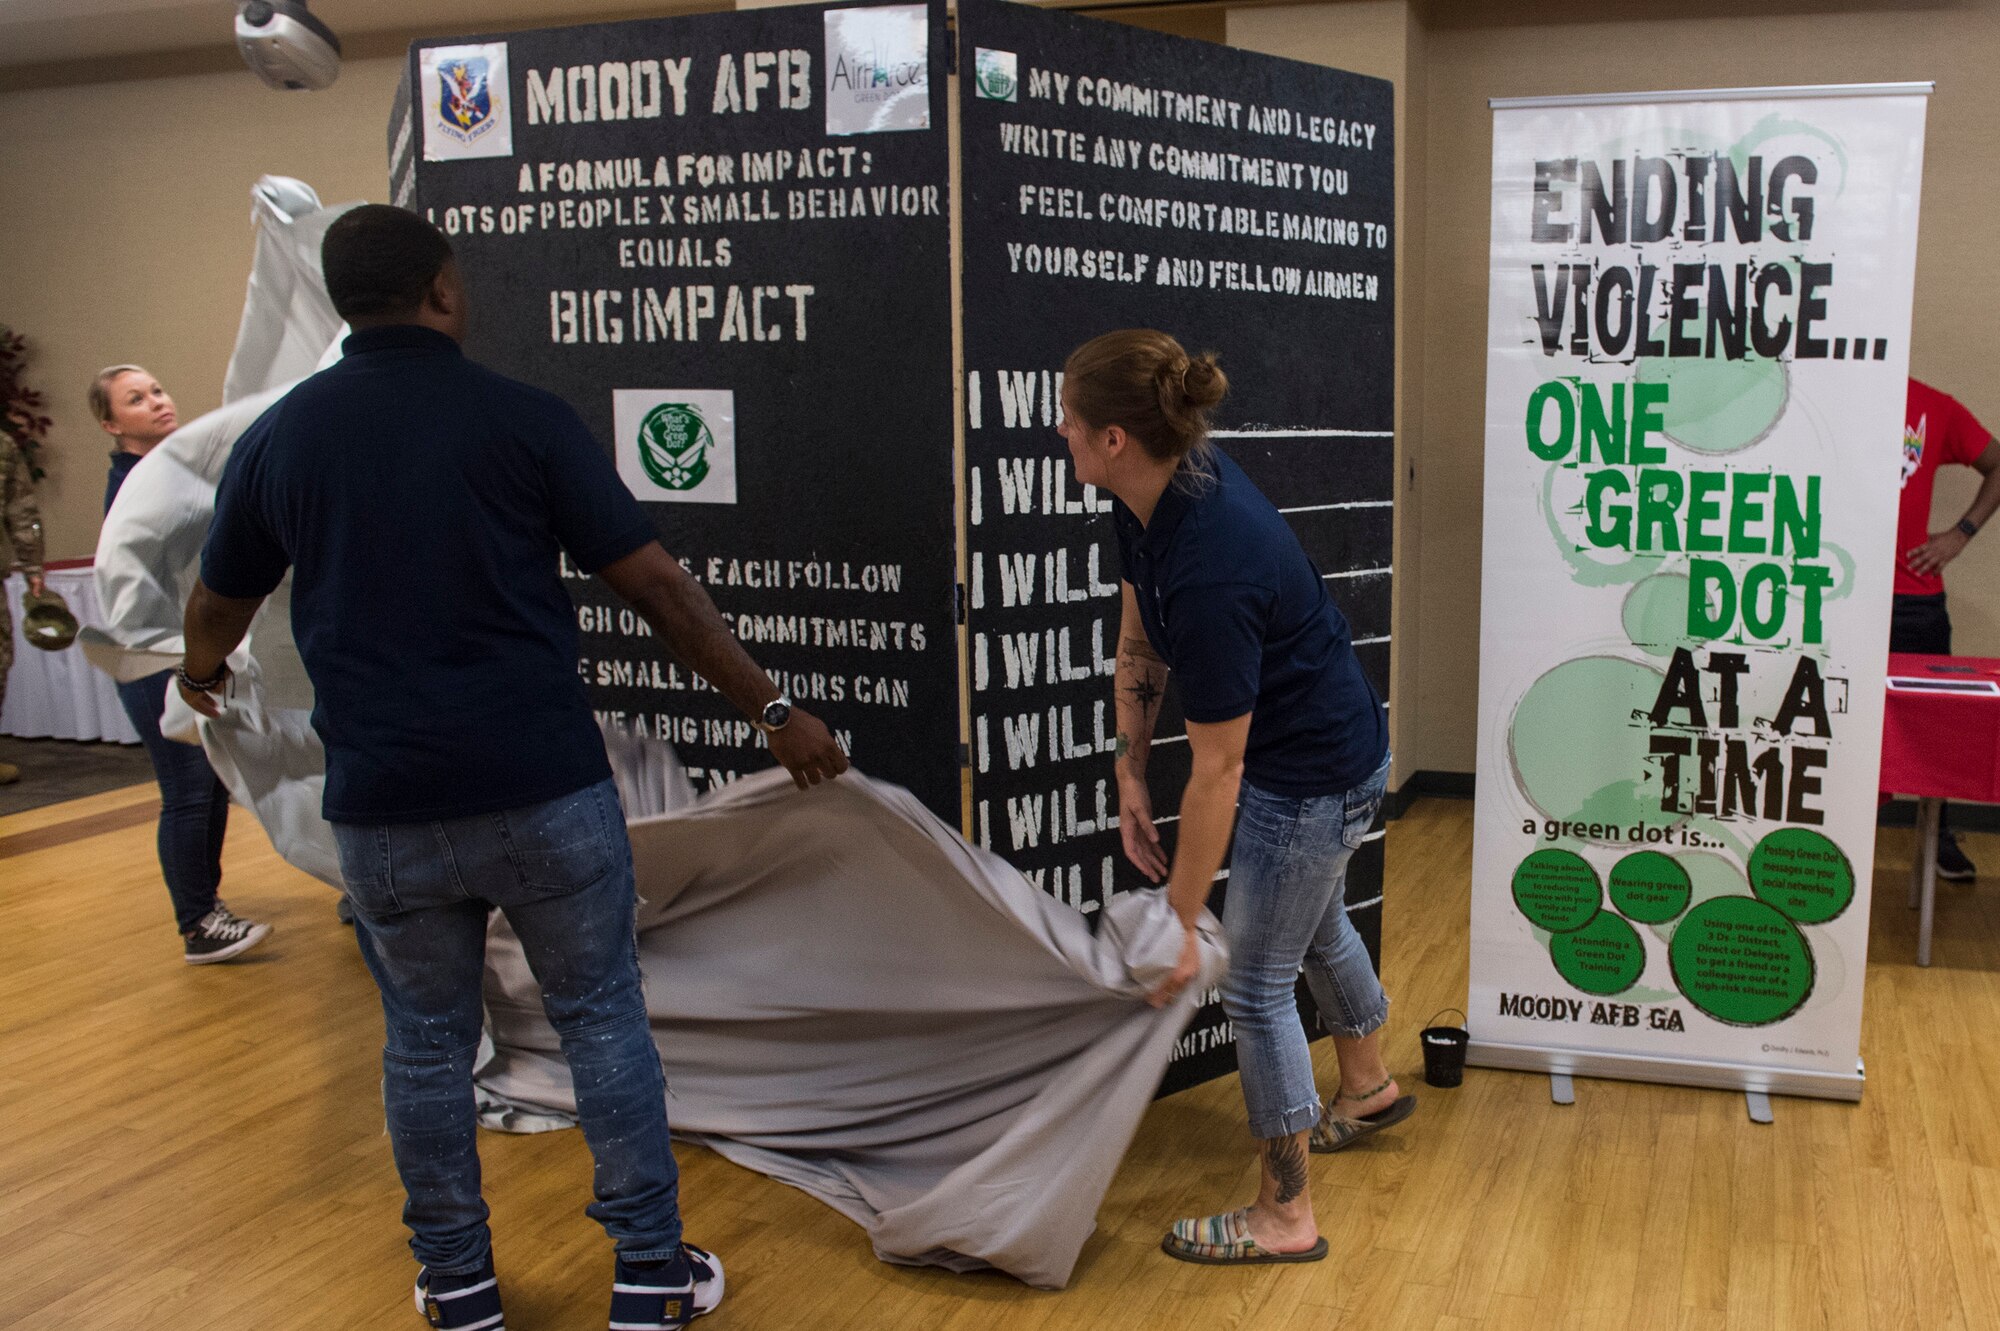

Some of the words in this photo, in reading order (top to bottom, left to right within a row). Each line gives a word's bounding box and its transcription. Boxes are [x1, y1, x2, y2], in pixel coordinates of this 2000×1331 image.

[526, 57, 693, 125] MOODY
[712, 49, 811, 113] AFB
[1029, 67, 1069, 105] MY
[1077, 76, 1241, 129] COMMITMENT
[1247, 104, 1292, 136] AND
[1296, 112, 1376, 150] LEGACY
[518, 163, 535, 192] A
[539, 156, 670, 191] FORMULA
[677, 153, 735, 187] FOR
[1000, 122, 1086, 163] WRITE
[1093, 136, 1143, 170] ANY
[1148, 143, 1305, 191] COMMITMENT
[1309, 165, 1349, 195] YOU
[500, 204, 535, 235] OF
[540, 196, 649, 230] PEOPLE
[660, 195, 676, 225] X
[683, 189, 779, 225] SMALL
[788, 185, 941, 222] BEHAVIOR
[1019, 184, 1093, 220] FEEL
[1099, 192, 1279, 239] COMFORTABLE
[1283, 212, 1358, 247] MAKING
[1364, 222, 1387, 249] TO
[1531, 155, 1819, 245] ENDING
[619, 238, 732, 268] EQUALS
[1007, 242, 1149, 284] YOURSELF
[1156, 257, 1204, 288] AND
[1209, 261, 1302, 296] FELLOW
[1304, 270, 1379, 301] AIRMEN
[550, 290, 624, 344] BIG
[634, 284, 815, 343] IMPACT
[969, 371, 981, 429] I
[661, 414, 690, 424] What's
[667, 424, 686, 433] Your
[1526, 380, 1670, 465] ONE
[663, 431, 688, 441] Green
[971, 466, 982, 525] I
[1584, 469, 1823, 558] GREEN
[707, 557, 780, 588] EACH
[788, 560, 902, 593] FOLLOW
[972, 552, 984, 609] I
[999, 543, 1118, 607] WILL
[1687, 558, 1835, 644] DOT
[975, 632, 989, 691] I
[1002, 618, 1116, 690] WILL
[596, 659, 685, 690] SMALL
[854, 674, 909, 708] CAN
[1650, 646, 1751, 729] AT
[1772, 654, 1833, 738] A
[655, 713, 698, 744] BIG
[977, 713, 990, 773] I
[1004, 699, 1117, 771] WILL
[1648, 735, 1829, 825] TIME
[979, 800, 991, 851] I
[1007, 779, 1122, 851] WILL
[1522, 819, 1537, 835] a
[1544, 818, 1621, 842] green
[1627, 821, 1674, 845] dot
[1680, 824, 1726, 849] is...
[1529, 861, 1559, 872] Talking
[1560, 863, 1586, 872] about
[1764, 844, 1795, 860] Posting
[1796, 848, 1822, 861] Green
[1541, 873, 1592, 884] commitment
[1543, 884, 1580, 894] reducing
[1612, 877, 1654, 890] Wearing
[1656, 882, 1686, 892] green
[1519, 893, 1553, 901] violence
[1554, 893, 1573, 903] with
[1534, 902, 1559, 912] family
[1560, 905, 1577, 913] and
[1626, 891, 1645, 901] dot
[1646, 895, 1671, 905] gear
[1571, 937, 1622, 949] Attending
[1703, 919, 1733, 931] Using
[1735, 923, 1754, 931] one
[1757, 925, 1768, 933] of
[1769, 926, 1787, 936] the
[1708, 932, 1714, 940] 3
[1575, 950, 1606, 959] Green
[1607, 952, 1627, 961] Dot
[1580, 961, 1621, 975] Training
[1696, 956, 1707, 965] to
[1709, 958, 1726, 968] get
[1737, 959, 1768, 970] friend
[1770, 965, 1781, 973] or
[1697, 943, 1728, 955] Direct
[1730, 947, 1742, 955] or
[1744, 948, 1790, 961] Delegate
[1697, 969, 1746, 982] colleague
[1748, 974, 1767, 983] out
[1769, 975, 1779, 984] of
[1743, 986, 1789, 998] situation
[1499, 992, 1583, 1021] MOODY
[1590, 1001, 1640, 1028] AFB
[1647, 1007, 1685, 1033] GA
